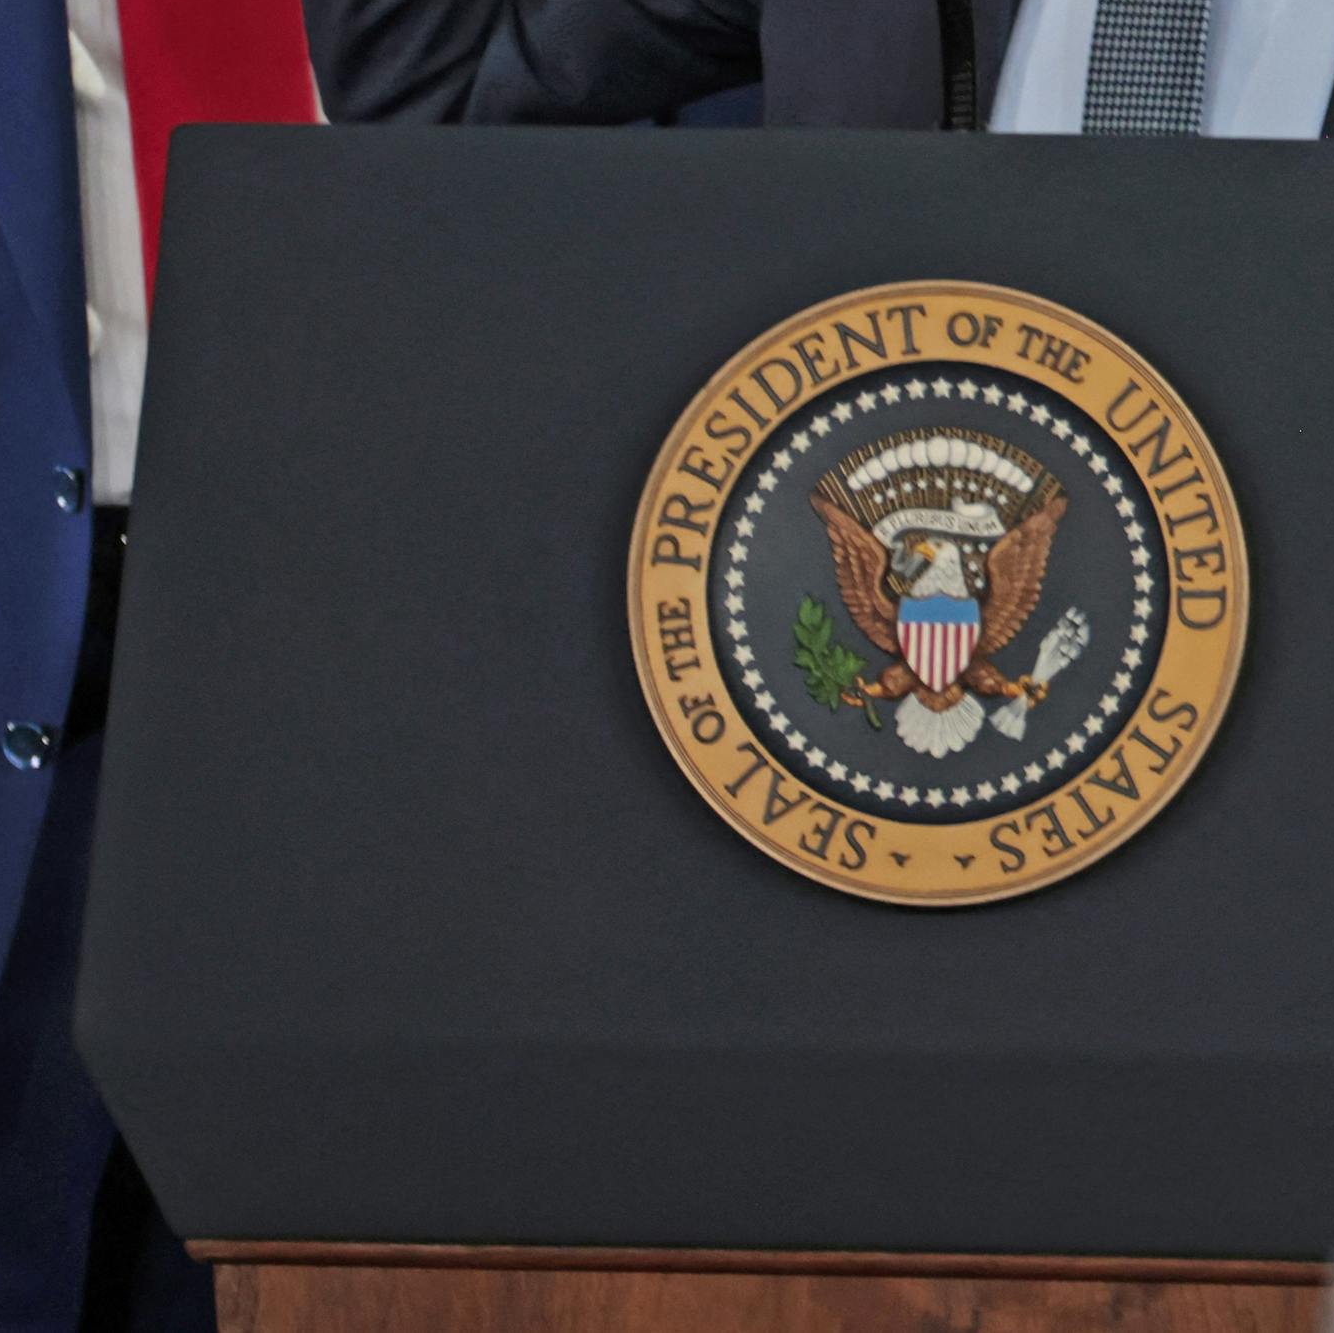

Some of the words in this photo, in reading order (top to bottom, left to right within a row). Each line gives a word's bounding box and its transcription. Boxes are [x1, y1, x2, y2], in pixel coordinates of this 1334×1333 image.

[946, 311, 1004, 349] OF
[1018, 325, 1091, 384] THE
[652, 304, 927, 574] PRESIDENT
[1104, 379, 1228, 632] UNITED
[657, 596, 702, 681] THE
[679, 691, 726, 747] OF
[723, 741, 877, 872] SEAL
[988, 688, 1199, 875] STATES
